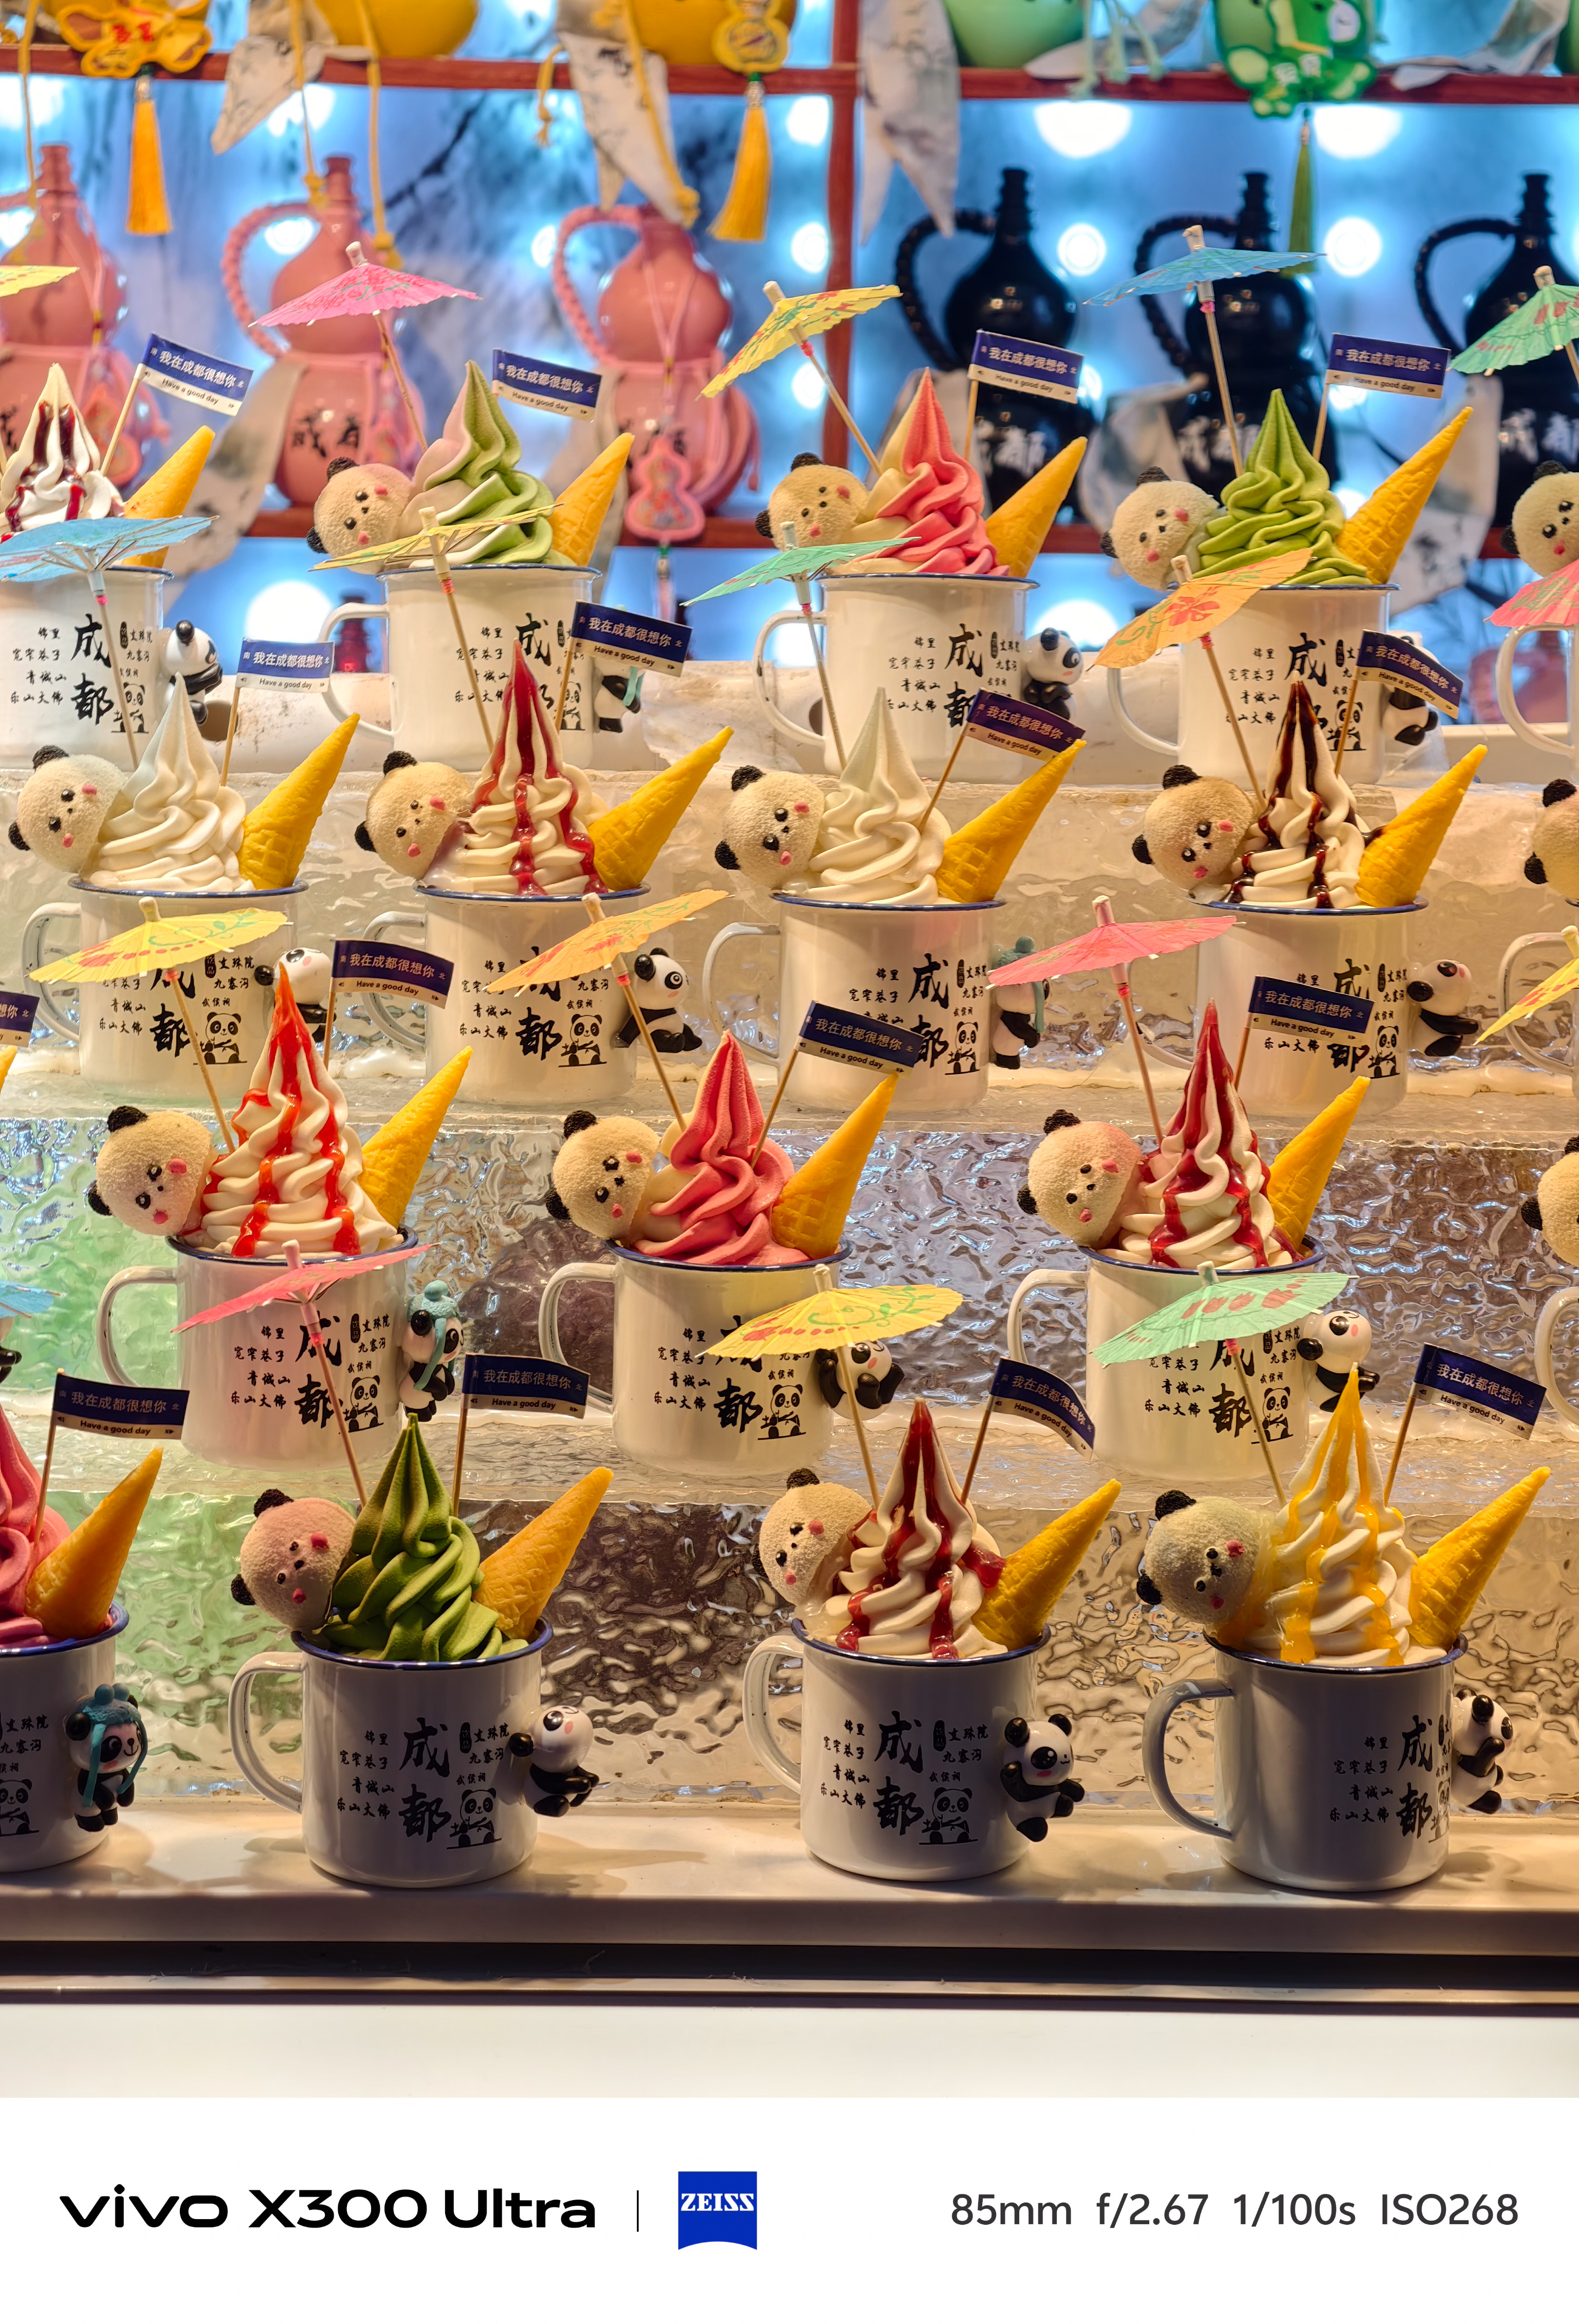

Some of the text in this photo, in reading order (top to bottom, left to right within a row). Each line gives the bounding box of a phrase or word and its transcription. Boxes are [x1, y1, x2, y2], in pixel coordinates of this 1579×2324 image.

[159, 350, 237, 388] 我在成都很想你
[506, 365, 584, 393] 我在成都很想你
[162, 378, 179, 390] Have
[187, 389, 205, 399] good
[207, 394, 219, 405] day
[512, 391, 528, 401] Have
[536, 399, 554, 407] good
[555, 403, 568, 411] day
[589, 618, 672, 647] 我在成都很想你
[253, 652, 323, 668] 我在成都很想你
[594, 646, 613, 655] Have
[642, 657, 655, 666] day
[71, 613, 115, 725] 成都
[986, 706, 1064, 739] 我在成都很想你
[987, 733, 1004, 743] Have
[1011, 742, 1029, 751] good
[1029, 746, 1042, 755] day
[350, 953, 435, 978] 我在成都很想你
[485, 960, 505, 972] 锦里
[876, 968, 899, 981] 锦里
[405, 987, 418, 995] day
[850, 989, 898, 1003] 宽窄巷子
[111, 998, 145, 1013] 青城山
[473, 1003, 511, 1018] 青城山
[1265, 991, 1353, 1018] 我在成都很想你
[815, 1018, 903, 1051] 我在成都很想你
[1271, 1019, 1290, 1028] Have
[1298, 1025, 1318, 1033] good
[1320, 1028, 1335, 1038] day
[820, 1047, 839, 1057] Have
[847, 1055, 868, 1064] good
[869, 1060, 884, 1069] day
[261, 1326, 284, 1339] 锦里
[683, 1328, 705, 1342] 锦里
[234, 1346, 284, 1362] 宽窄巷子
[248, 1370, 290, 1387] 青城山
[295, 1310, 344, 1430] 成都
[484, 1369, 572, 1389] 我在成都很想你
[670, 1371, 710, 1389] 青城山
[1162, 1379, 1204, 1395] 青城山
[1437, 1364, 1524, 1405] 我在成都很想你
[71, 1392, 167, 1413] 我在成都很想你
[520, 1400, 539, 1408] good
[541, 1401, 556, 1410] day
[1012, 1375, 1086, 1425] 我在成都很想你
[1441, 1394, 1461, 1407] Have
[1470, 1405, 1490, 1418] good
[1492, 1413, 1505, 1424] day
[81, 1421, 101, 1429] Have
[1015, 1403, 1034, 1413] Have
[1041, 1412, 1061, 1427] good
[1061, 1426, 1072, 1437] day
[844, 1719, 865, 1736] 锦里
[365, 1731, 388, 1746] 锦里
[824, 1735, 865, 1759] 宽窄巷子
[1364, 1736, 1388, 1751] 锦里
[340, 1750, 388, 1770] 宽窄巷子
[1334, 1760, 1387, 1774] 宽窄巷子
[398, 1717, 453, 1843] 成都
[833, 1764, 870, 1785] 青城山
[873, 1711, 926, 1836] 成都
[1394, 1714, 1435, 1838] 成都
[352, 1776, 394, 1795] 青城山
[1349, 1784, 1393, 1801] 青城山
